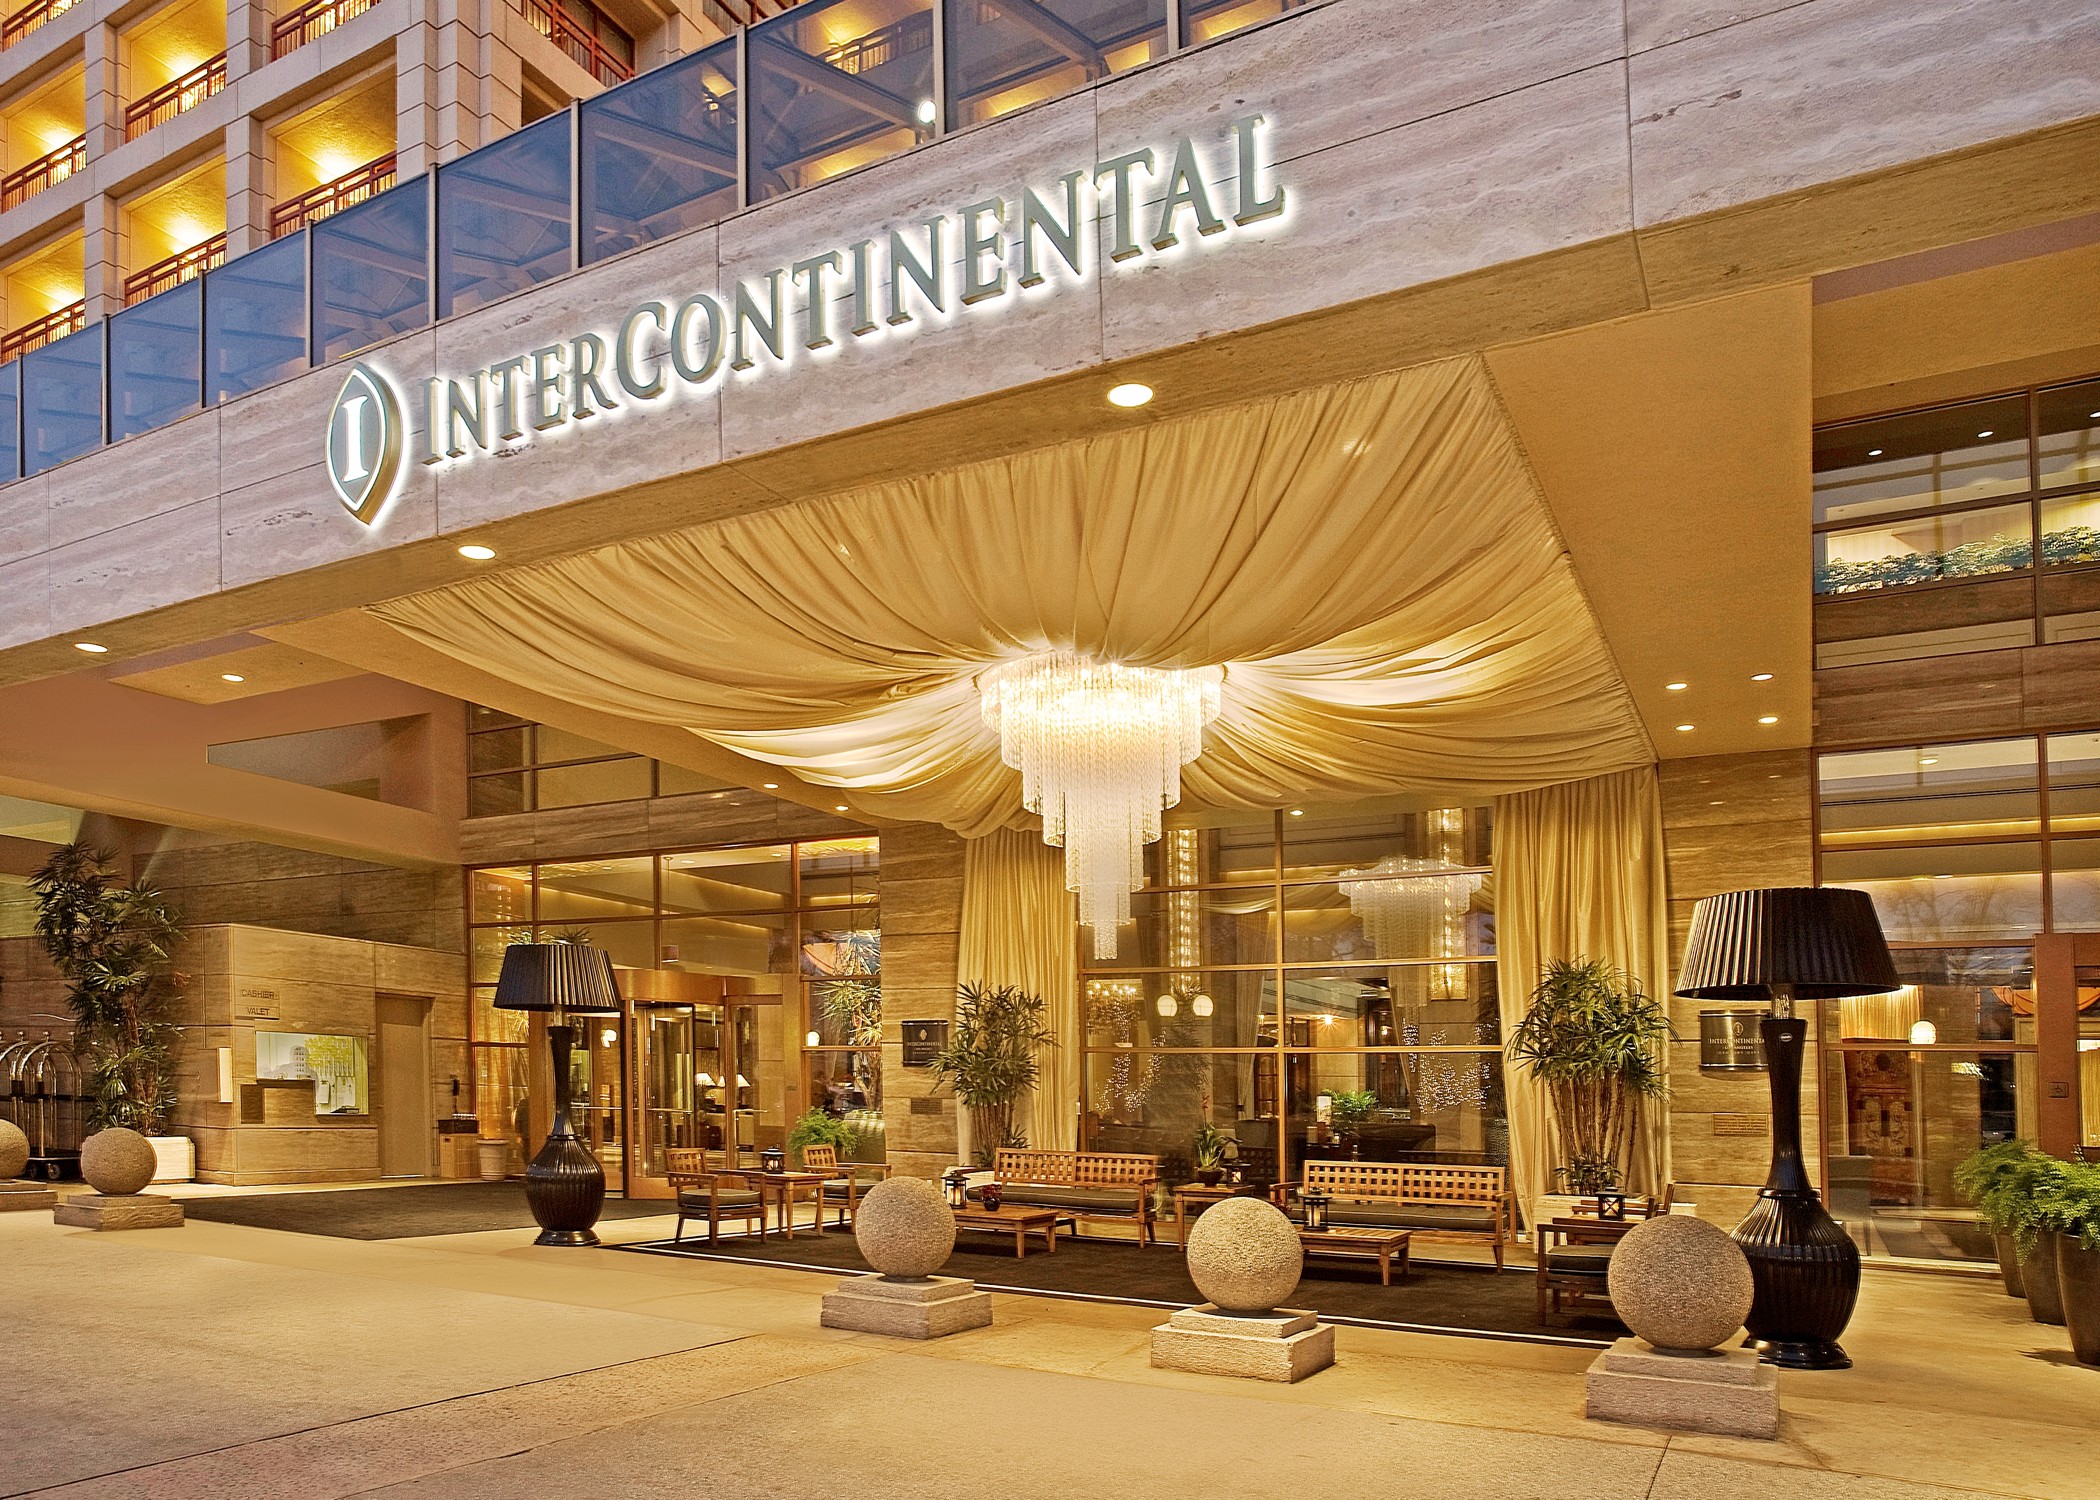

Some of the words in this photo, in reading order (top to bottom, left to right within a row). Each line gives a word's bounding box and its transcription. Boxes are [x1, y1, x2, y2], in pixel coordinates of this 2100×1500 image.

[421, 112, 1286, 466] INTERCONTINENTAL
[241, 989, 275, 999] CASHIER
[247, 1007, 270, 1016] VALET
